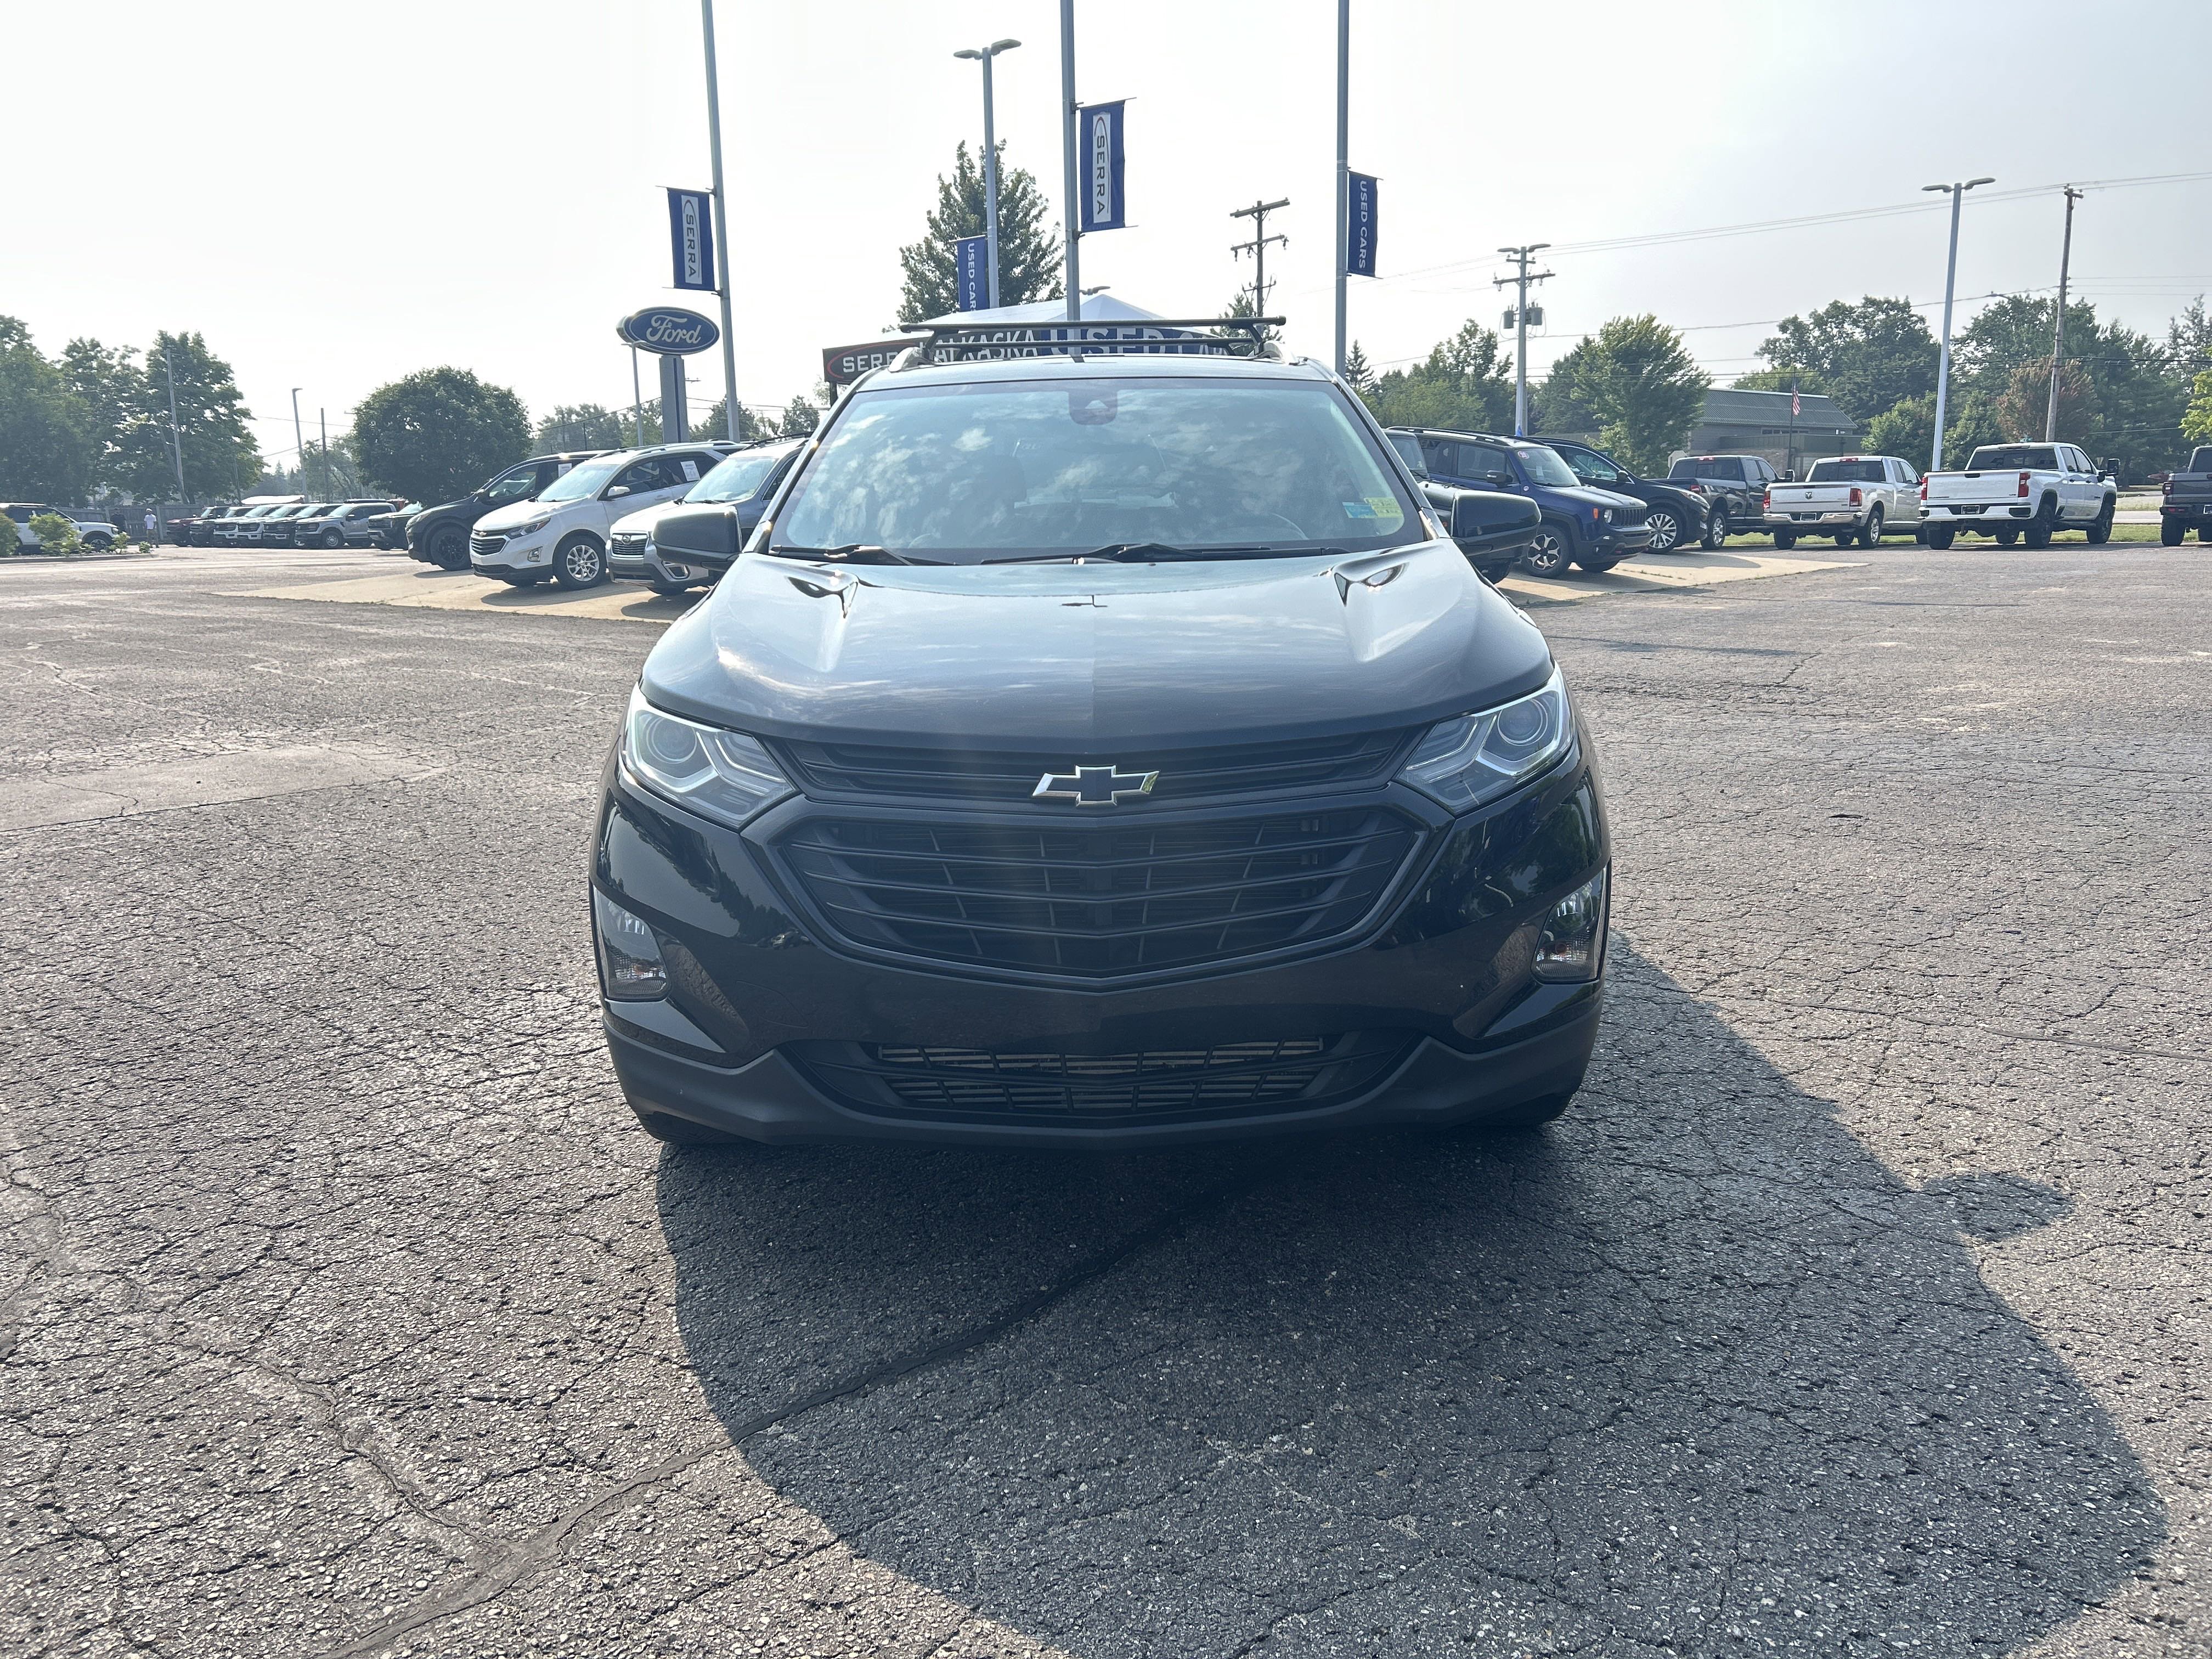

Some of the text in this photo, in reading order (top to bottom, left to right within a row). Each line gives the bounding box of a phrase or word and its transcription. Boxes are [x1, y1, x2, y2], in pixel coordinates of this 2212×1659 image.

[686, 213, 696, 277] SERRA
[1359, 227, 1368, 269] CARS
[646, 314, 702, 344] Ford
[843, 352, 901, 373] SERR
